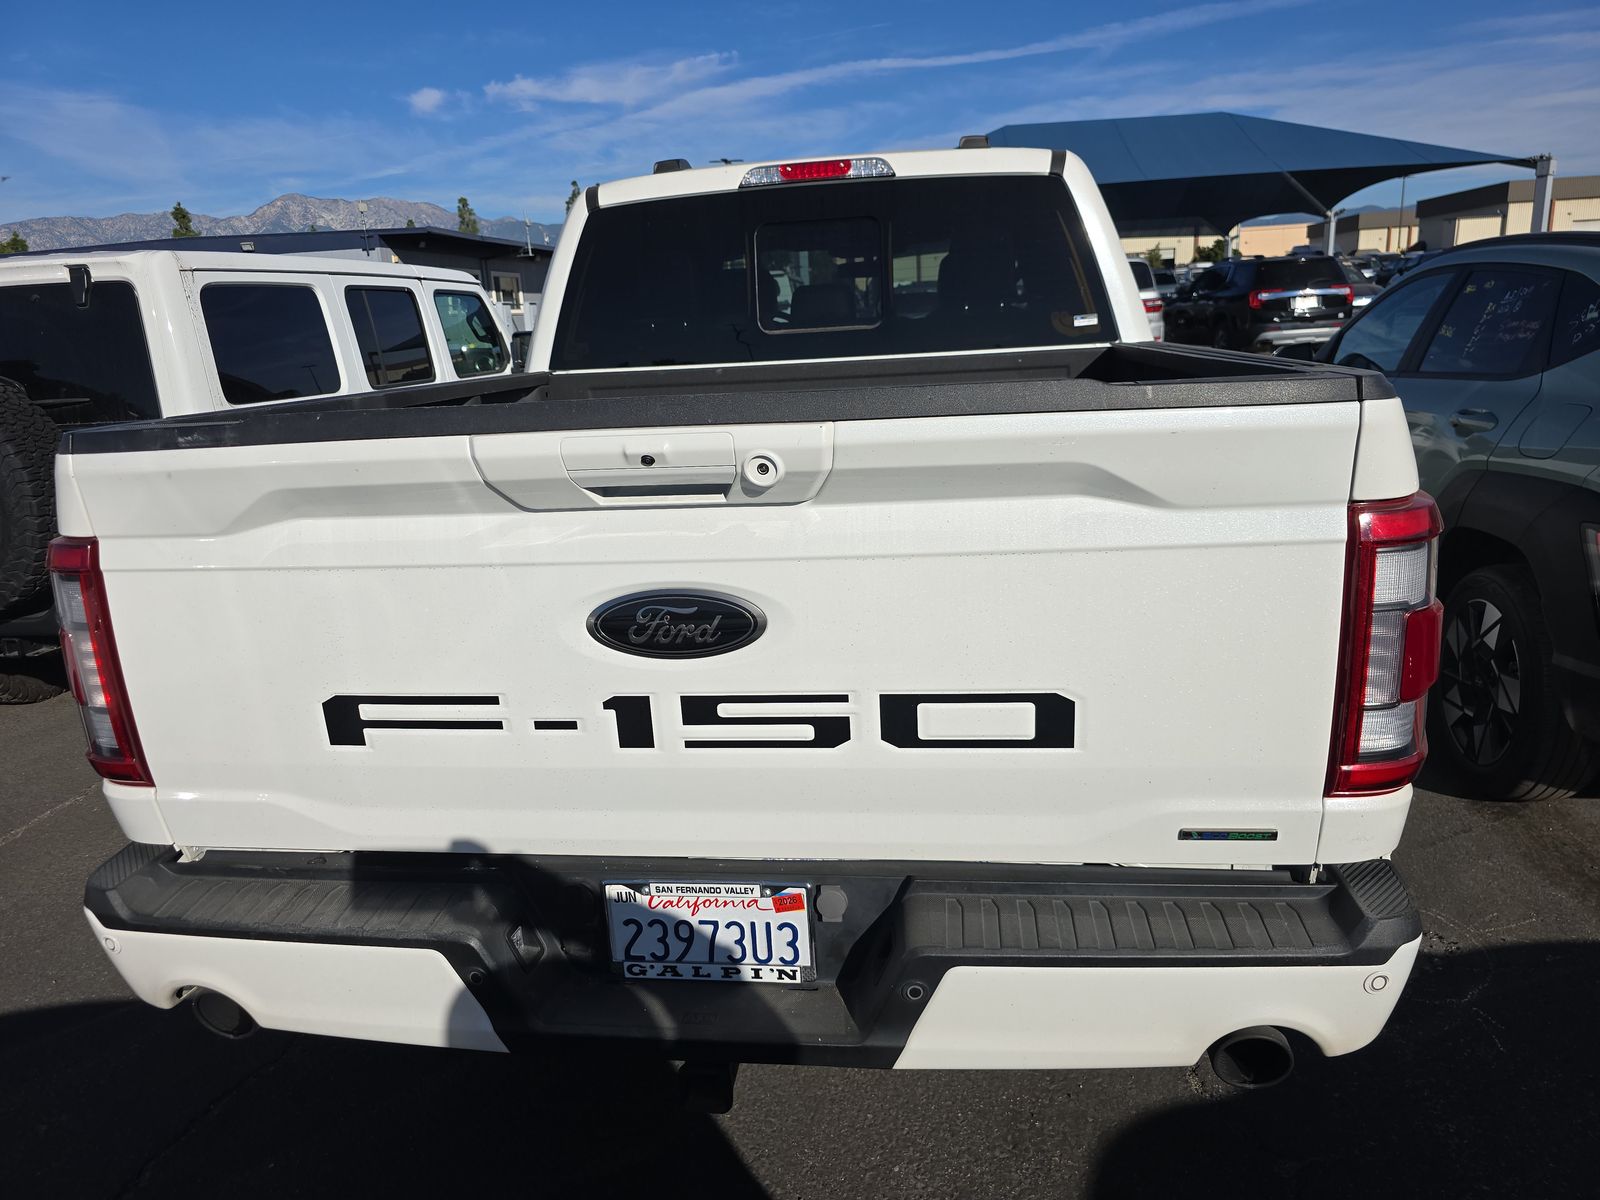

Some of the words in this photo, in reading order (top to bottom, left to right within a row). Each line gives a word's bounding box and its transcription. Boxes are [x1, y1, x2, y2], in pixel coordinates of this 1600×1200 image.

[627, 605, 722, 644] Ford
[322, 693, 1075, 748] F-150
[614, 891, 637, 903] JUN
[655, 886, 672, 894] SAN
[676, 886, 721, 894] FERNANDO
[724, 887, 755, 895] VALLEY
[648, 896, 773, 916] California
[778, 896, 798, 906] 2026
[623, 918, 800, 965] 23973U3
